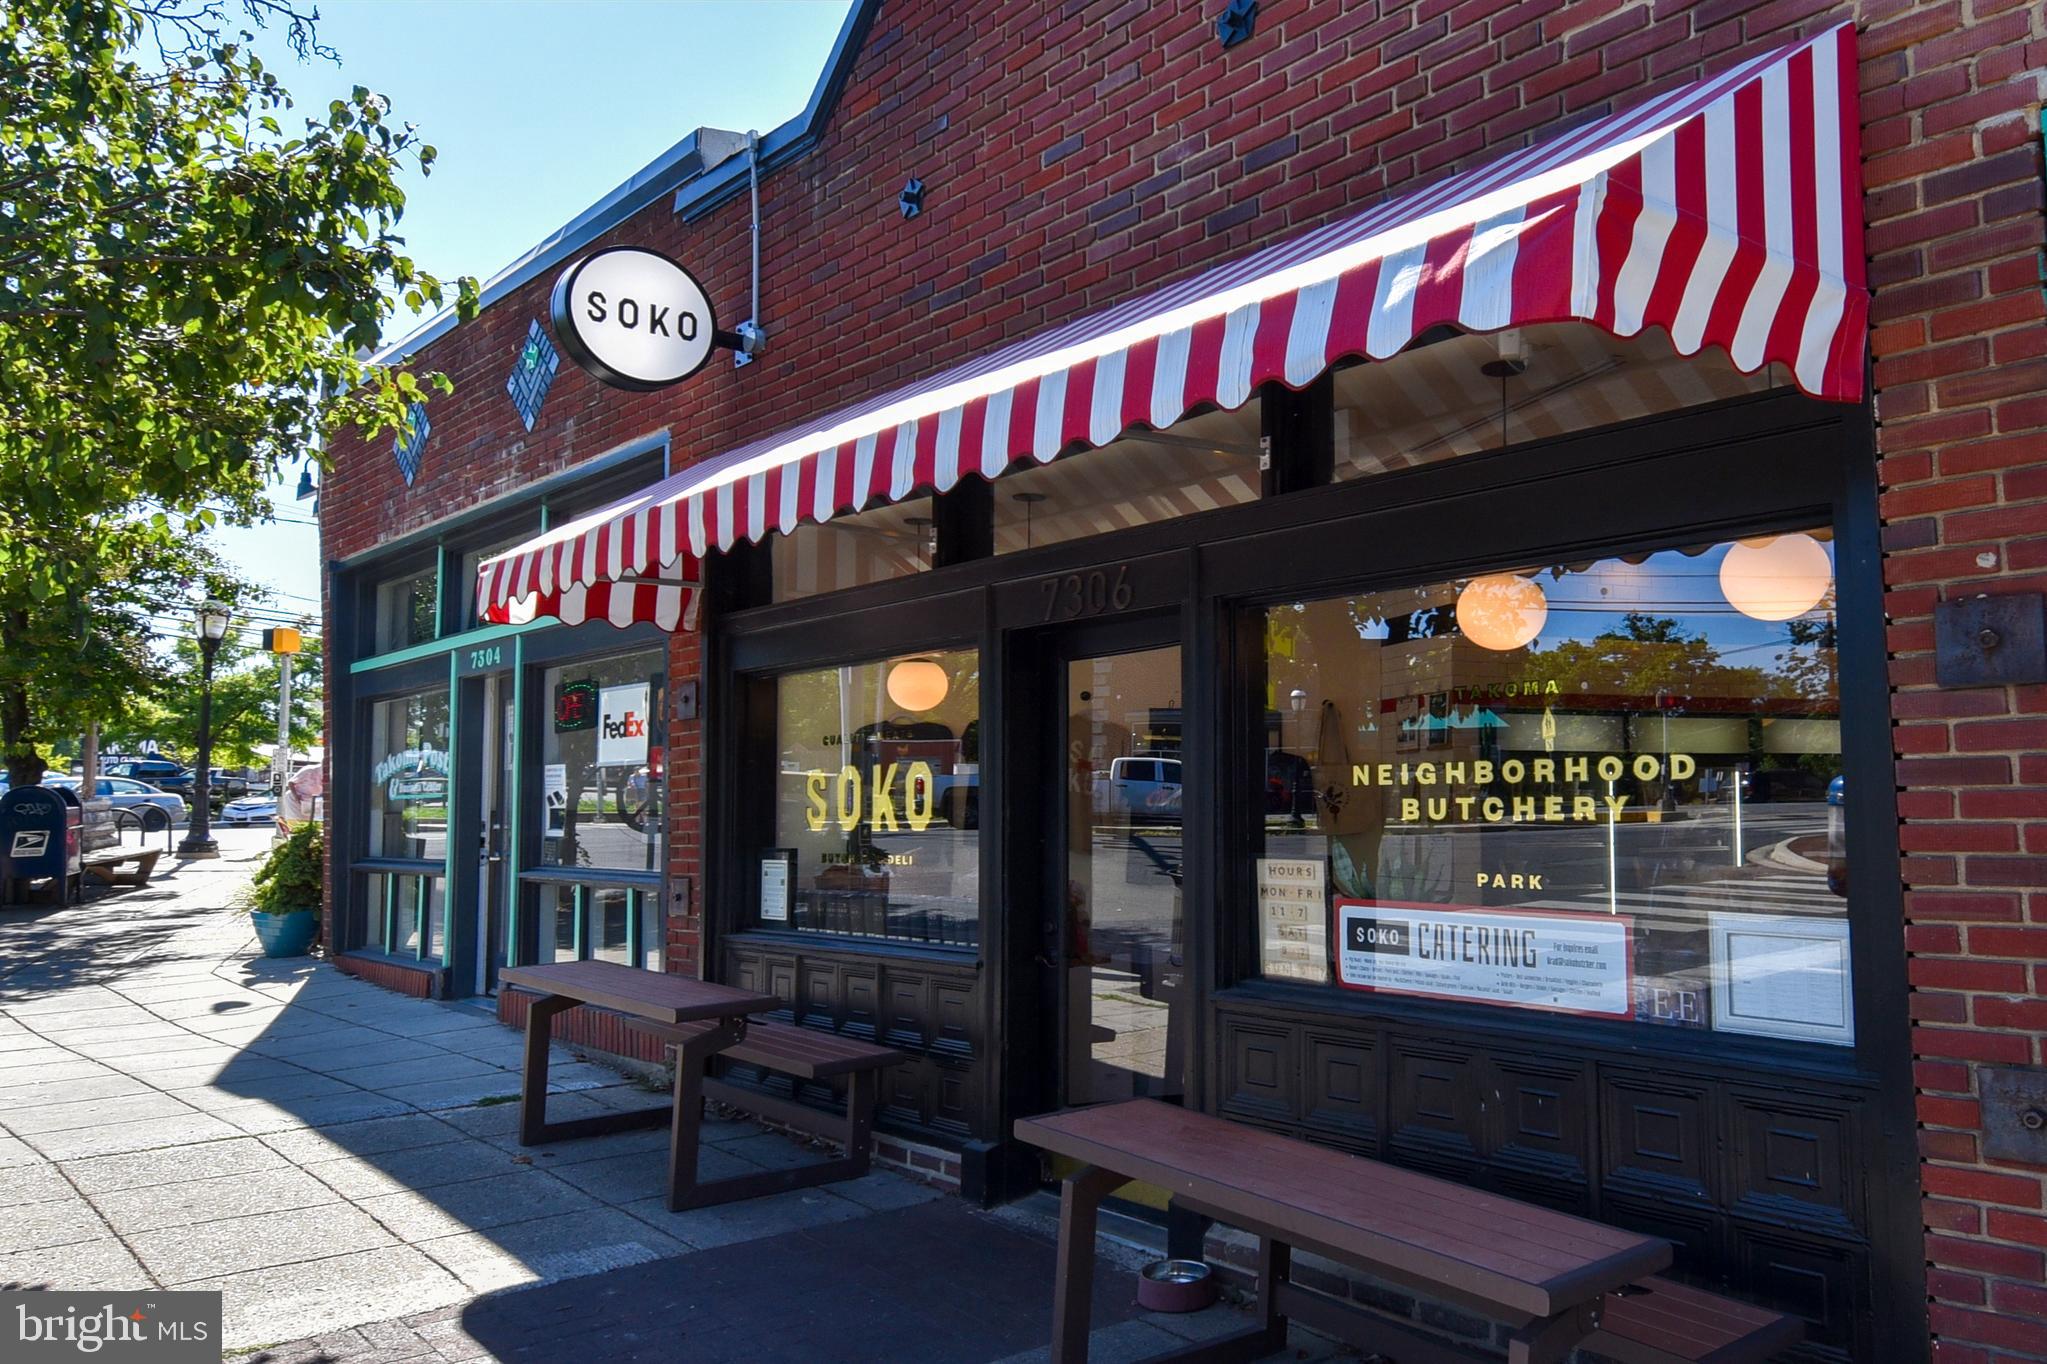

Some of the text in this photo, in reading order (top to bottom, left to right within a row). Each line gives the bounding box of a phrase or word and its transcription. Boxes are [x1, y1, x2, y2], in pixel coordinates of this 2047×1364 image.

[586, 290, 698, 342] SOKO
[1041, 566, 1133, 622] 7306
[471, 646, 501, 670] 7304
[1453, 679, 1560, 700] TAKOMA
[602, 711, 645, 740] FedEx
[1352, 754, 1696, 786] NEIGHBORHOOD
[806, 761, 933, 832] SOKO
[1400, 795, 1629, 822] BUTCHERY
[887, 854, 913, 866] DELI
[1268, 866, 1312, 877] HOURS
[1260, 887, 1322, 900] MON FRI
[1476, 872, 1544, 890] PARK
[1356, 922, 1537, 968] SOKO CATERING
[1634, 986, 1699, 1022] EE
